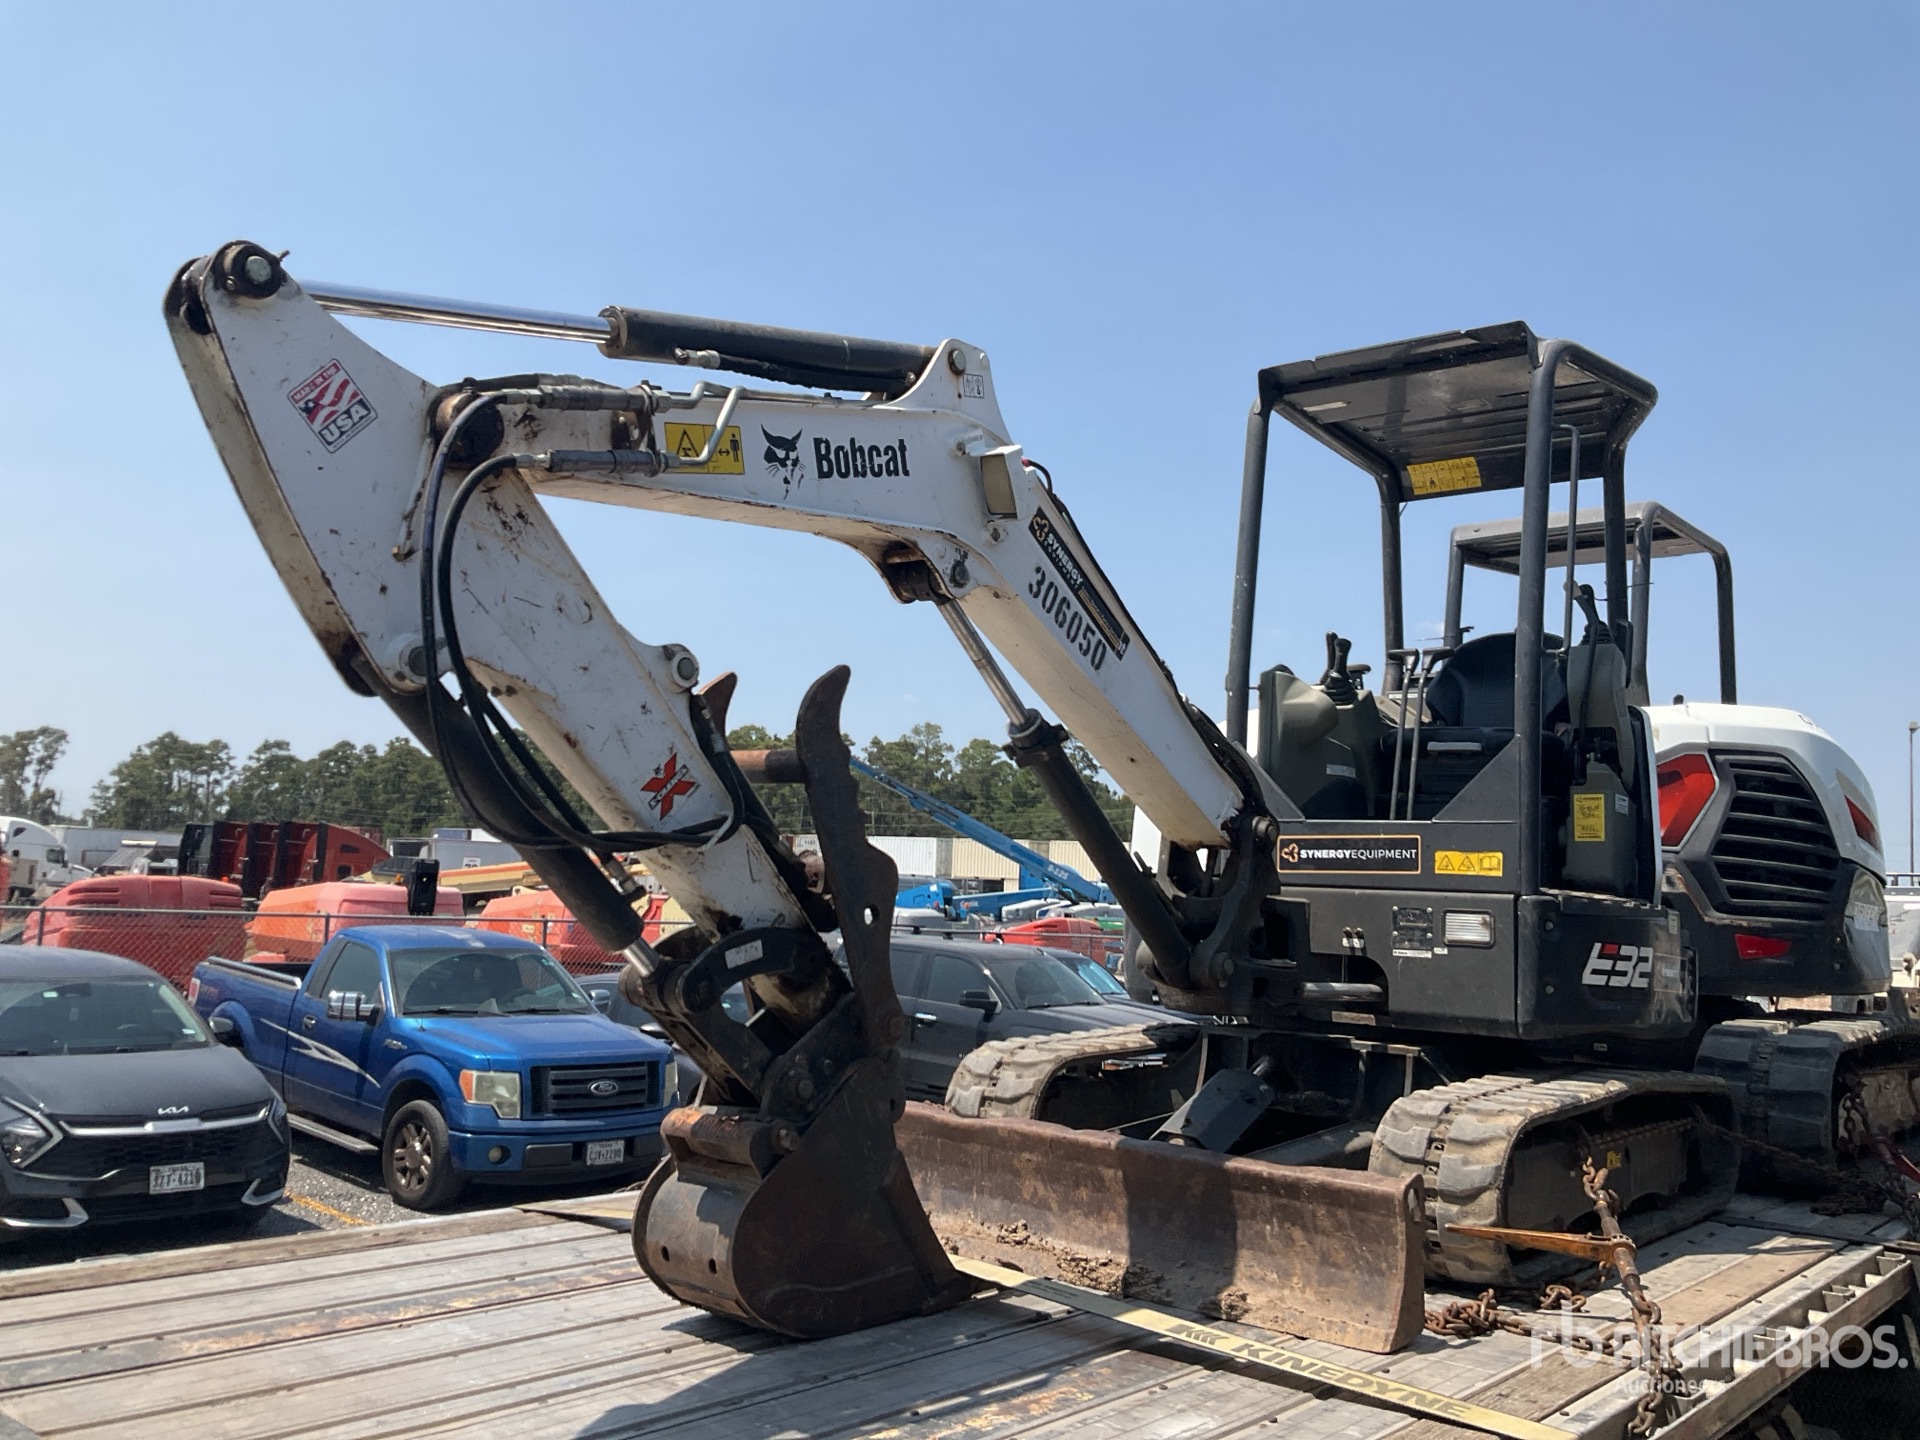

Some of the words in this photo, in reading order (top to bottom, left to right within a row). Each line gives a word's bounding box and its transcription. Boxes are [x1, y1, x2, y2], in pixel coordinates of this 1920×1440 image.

[293, 381, 316, 401] MADE
[320, 403, 371, 443] USA
[812, 436, 910, 480] Bobcat
[1043, 540, 1079, 591] EQUIPMENT
[1046, 532, 1084, 586] SYNERGY
[1028, 565, 1108, 672] 306050
[1581, 942, 1654, 989] E32
[1230, 1342, 1472, 1419] KINEDYNE
